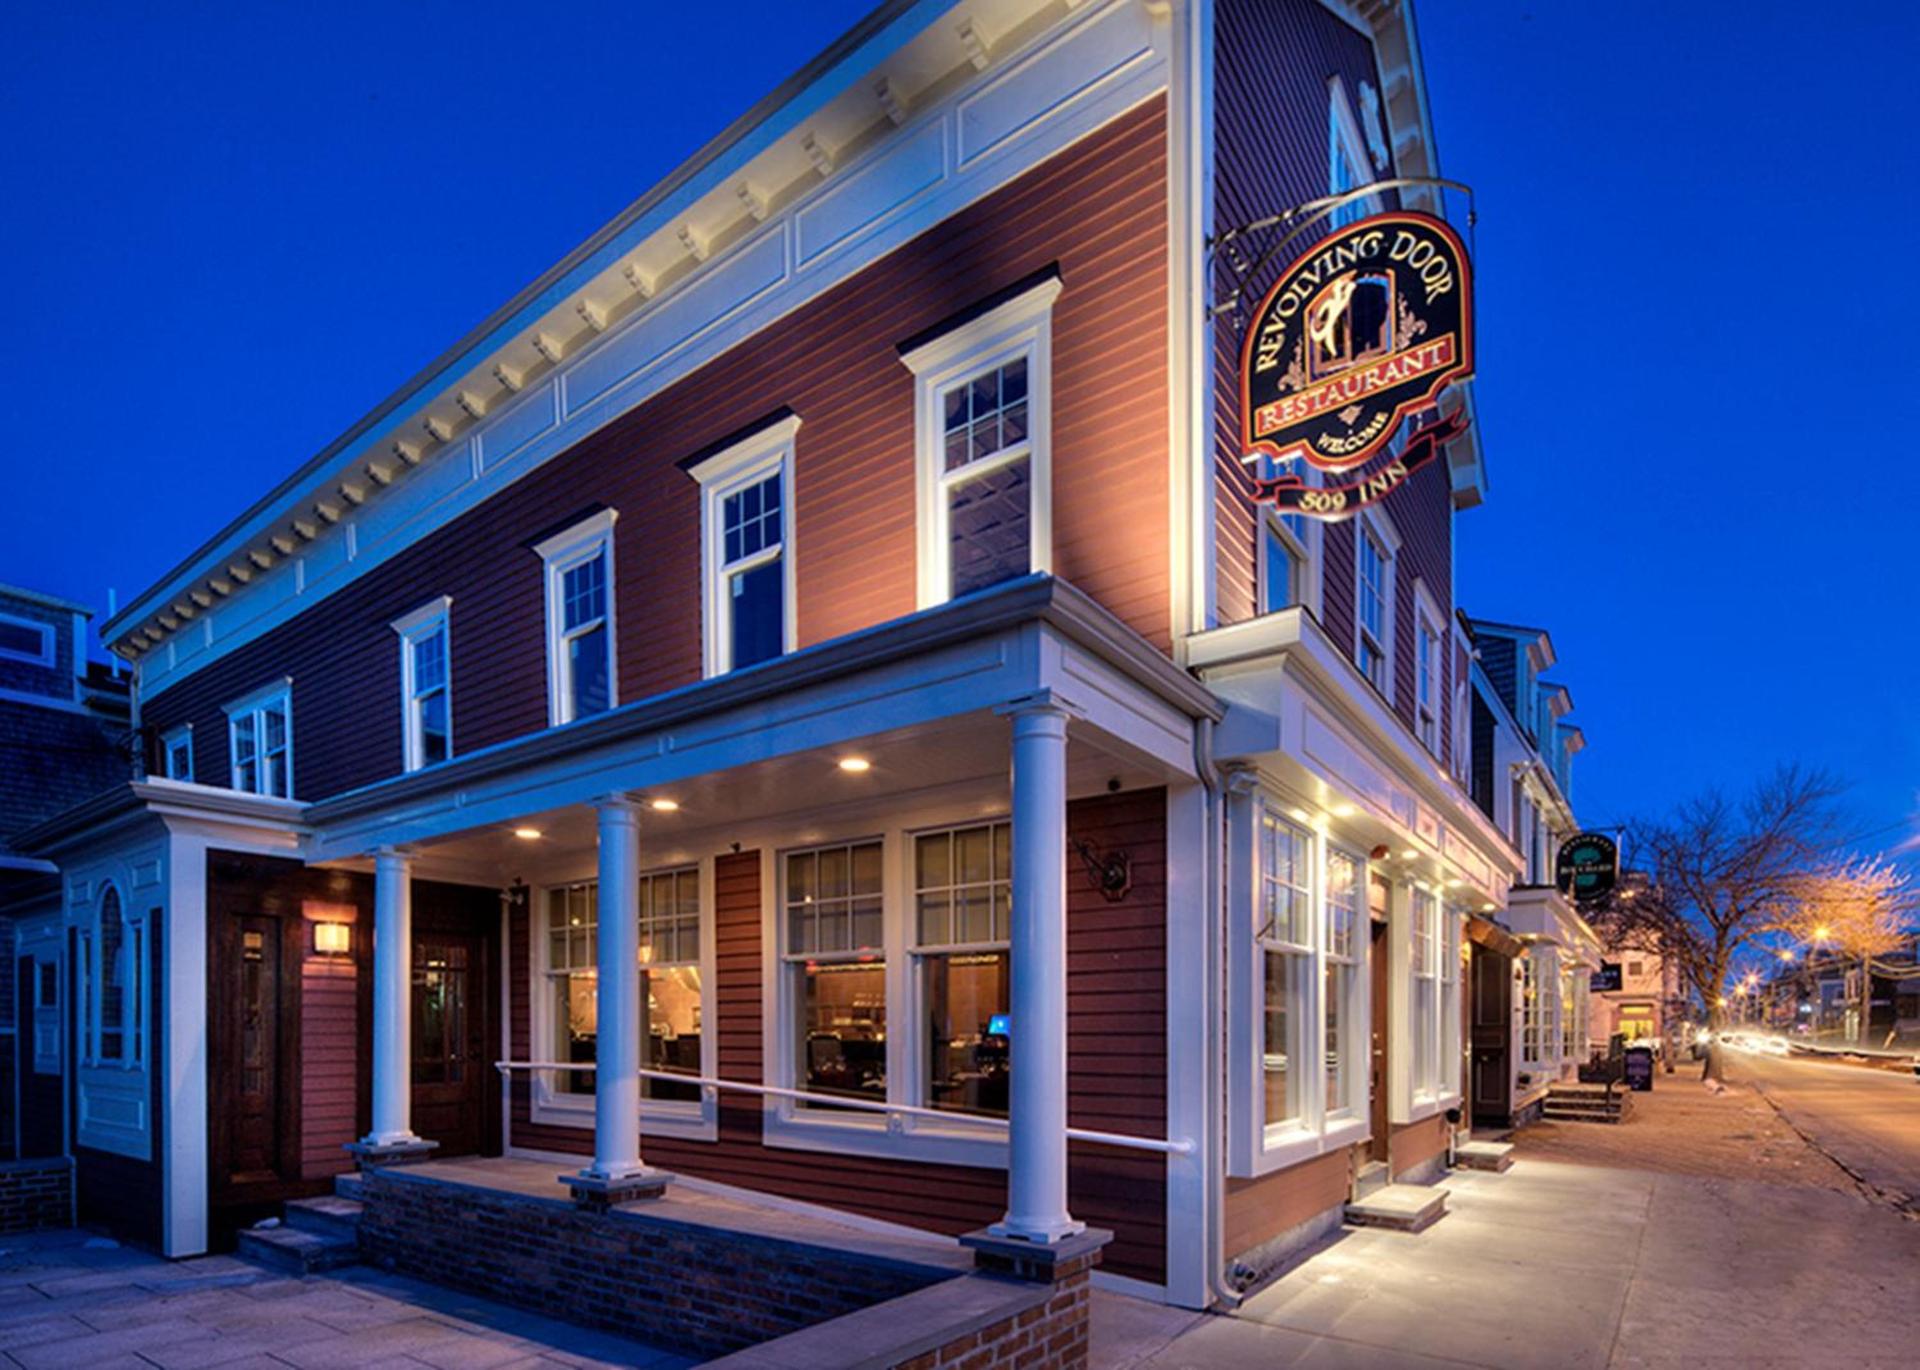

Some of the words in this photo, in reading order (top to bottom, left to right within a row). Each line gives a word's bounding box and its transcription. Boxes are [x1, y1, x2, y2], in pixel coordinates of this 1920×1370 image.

[1255, 231, 1384, 374] REVOLVING
[1389, 231, 1452, 305] DOOR
[1261, 341, 1446, 430] RESTAURANT
[1317, 411, 1389, 453] WELCOME
[1359, 460, 1407, 502] INN
